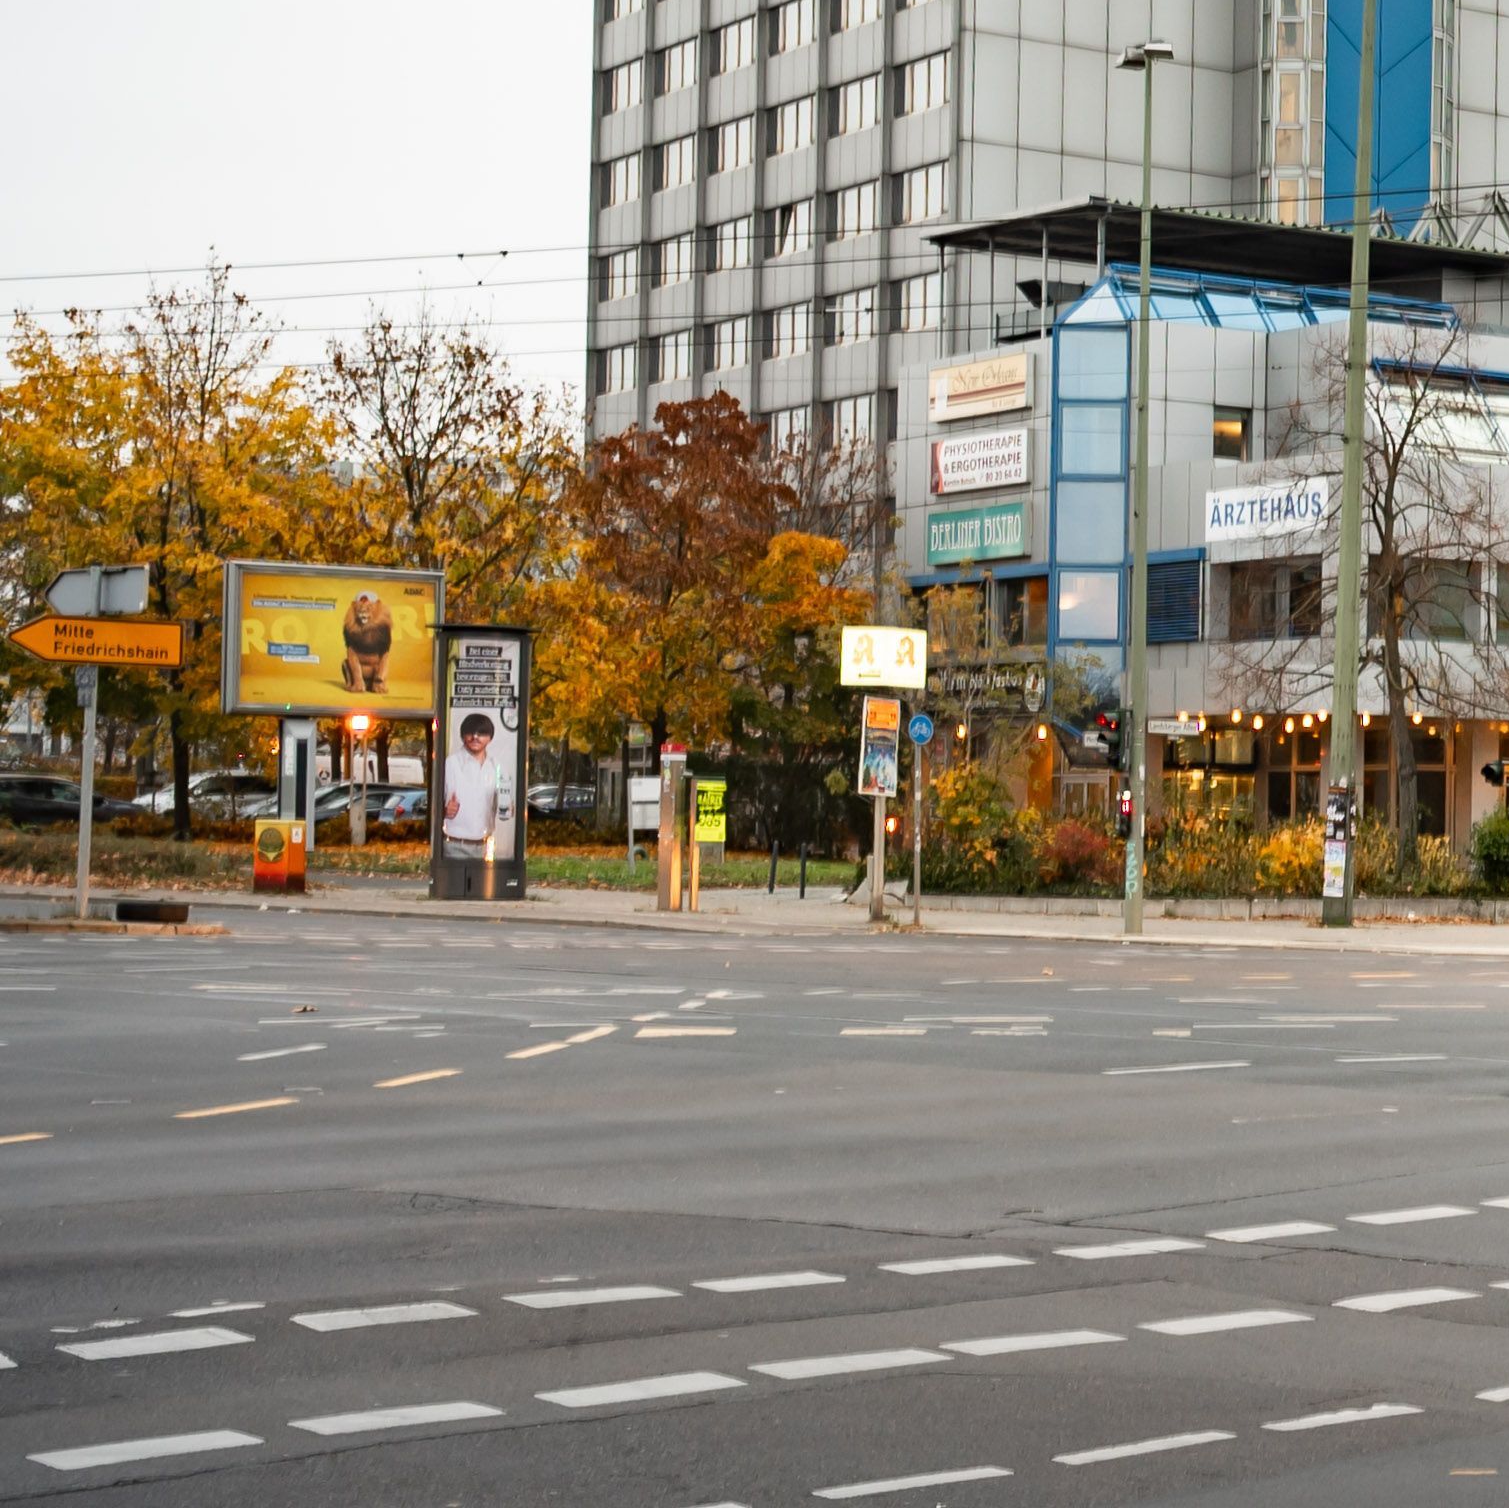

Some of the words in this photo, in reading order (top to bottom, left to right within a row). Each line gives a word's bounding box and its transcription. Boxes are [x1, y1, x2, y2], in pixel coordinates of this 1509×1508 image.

[943, 434, 1022, 458] PHYSIOTHERAPIE
[943, 462, 949, 474] &
[950, 451, 1022, 474] ERGOTHERAPIE
[1209, 491, 1323, 529] ÄRZTEHAUS
[930, 518, 981, 552] BERLINER
[983, 513, 1022, 547] BISTRO
[403, 587, 426, 597] ADAC
[54, 623, 94, 639] Mitte
[53, 641, 169, 660] Friedrichshain
